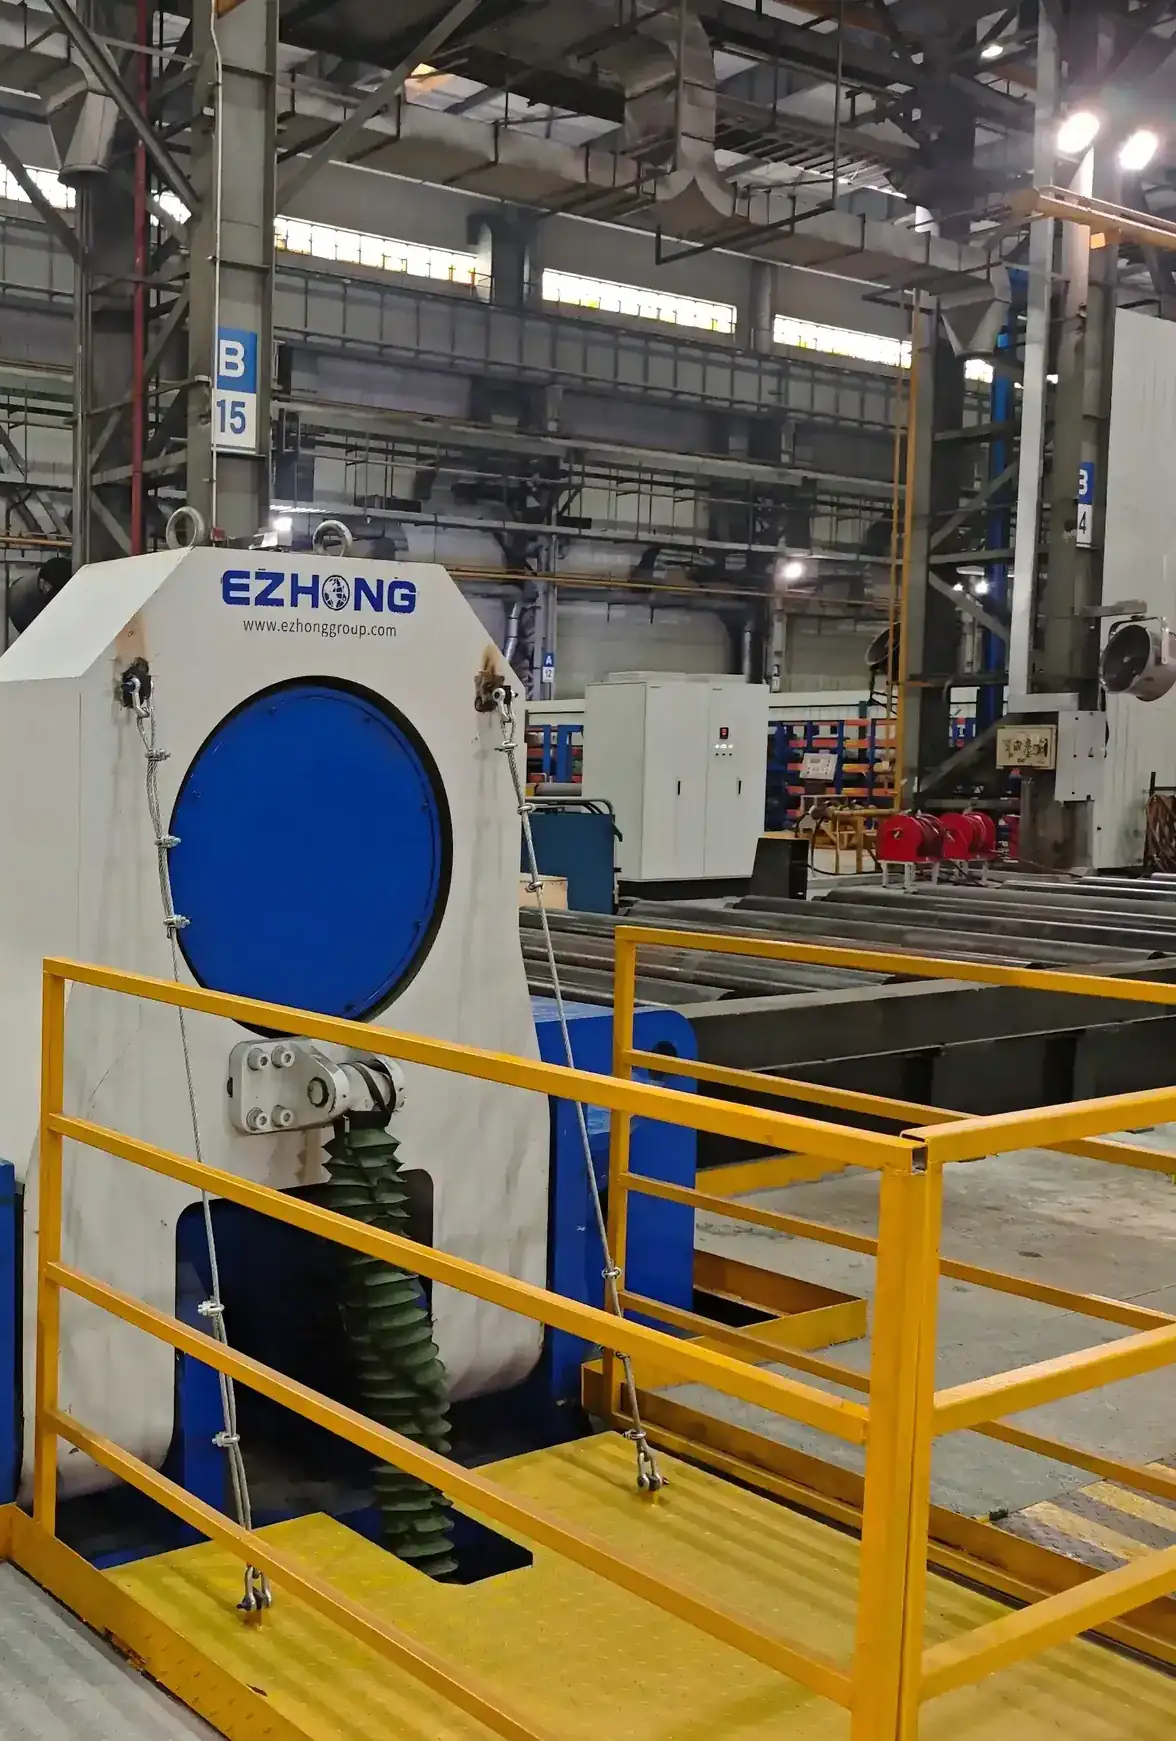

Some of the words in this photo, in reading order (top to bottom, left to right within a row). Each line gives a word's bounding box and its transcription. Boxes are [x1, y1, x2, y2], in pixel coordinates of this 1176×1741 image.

[219, 339, 245, 378] B
[216, 399, 246, 435] 15
[222, 569, 417, 614] EZHONG
[242, 617, 397, 639] www.ezhonggroup.com
[545, 655, 552, 665] A
